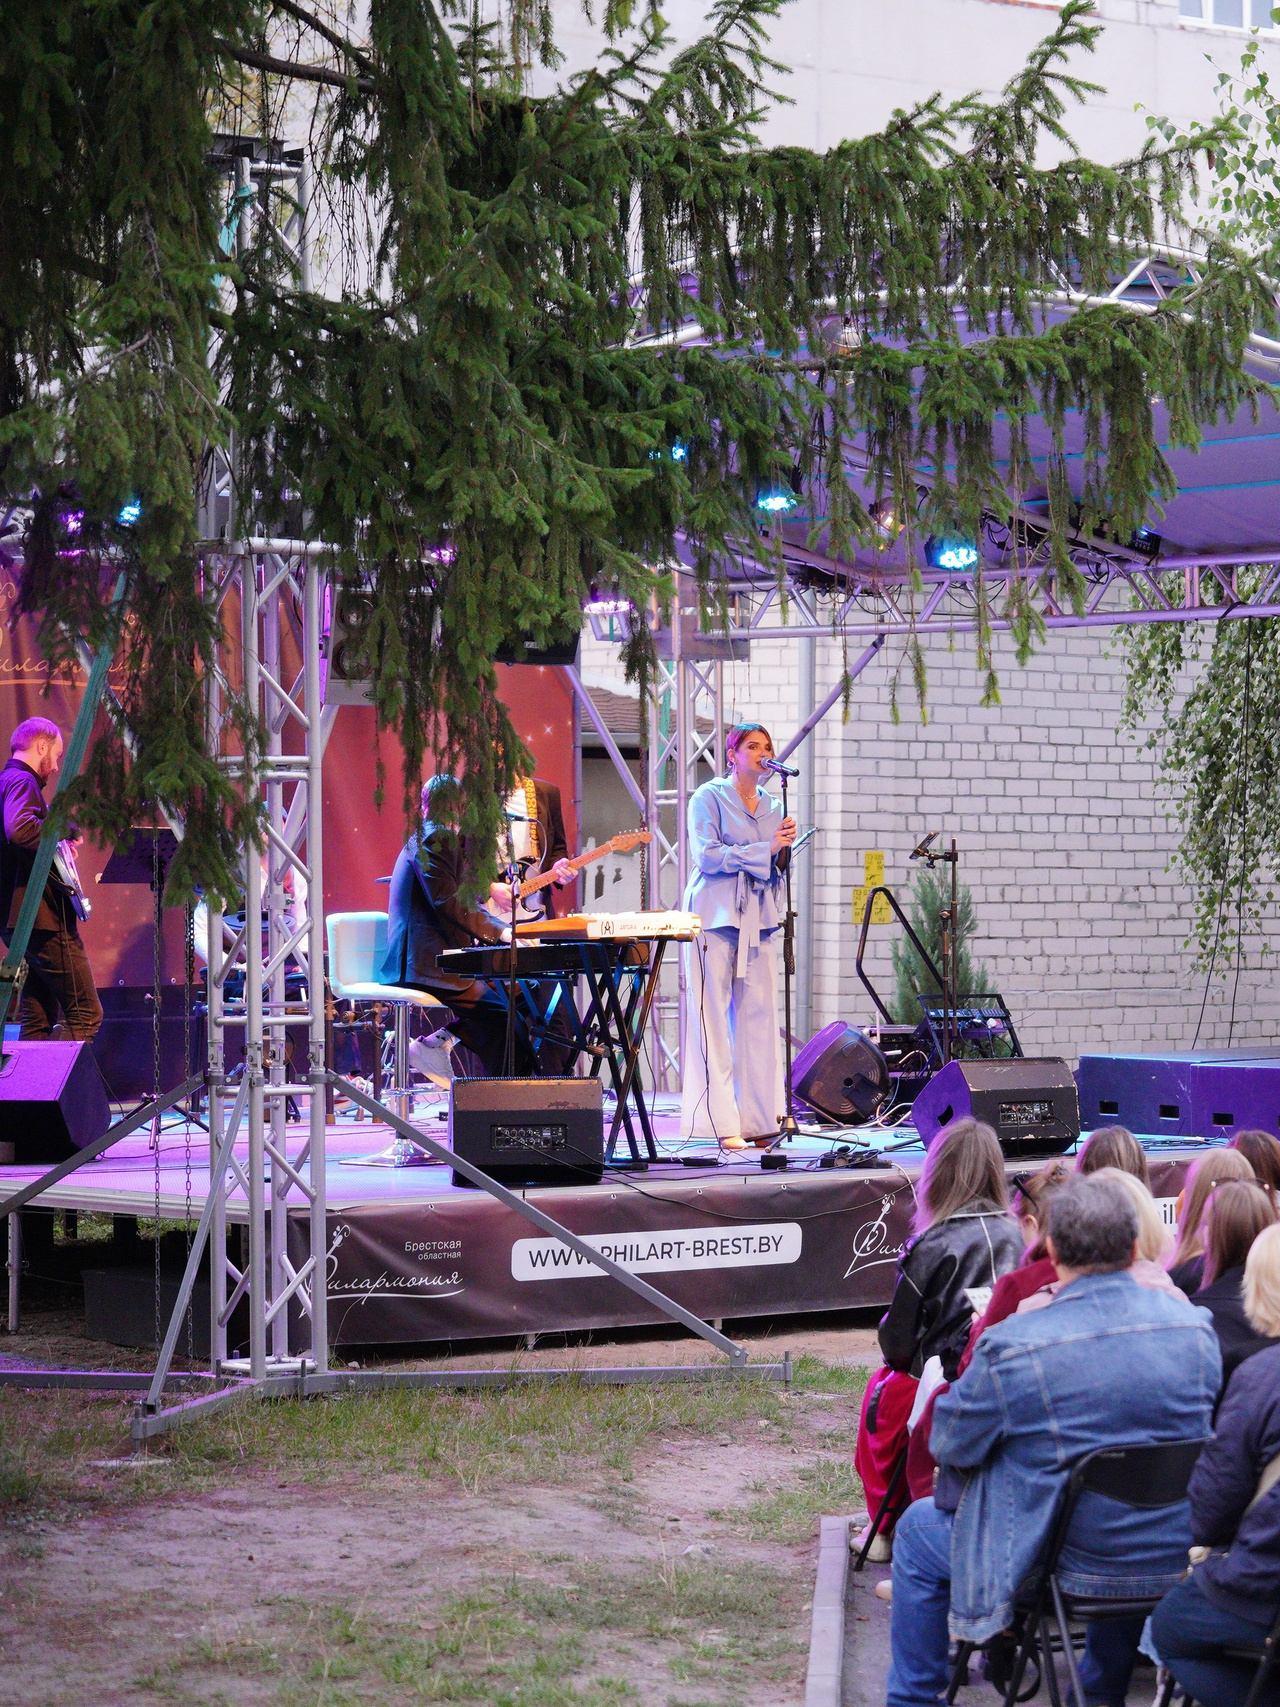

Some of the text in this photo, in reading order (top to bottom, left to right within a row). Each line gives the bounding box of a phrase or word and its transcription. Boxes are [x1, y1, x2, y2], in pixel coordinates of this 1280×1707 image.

[404, 1240, 462, 1252] Брестская
[528, 1234, 784, 1268] WWPHILART-BREST.BY
[418, 1251, 462, 1260] областная
